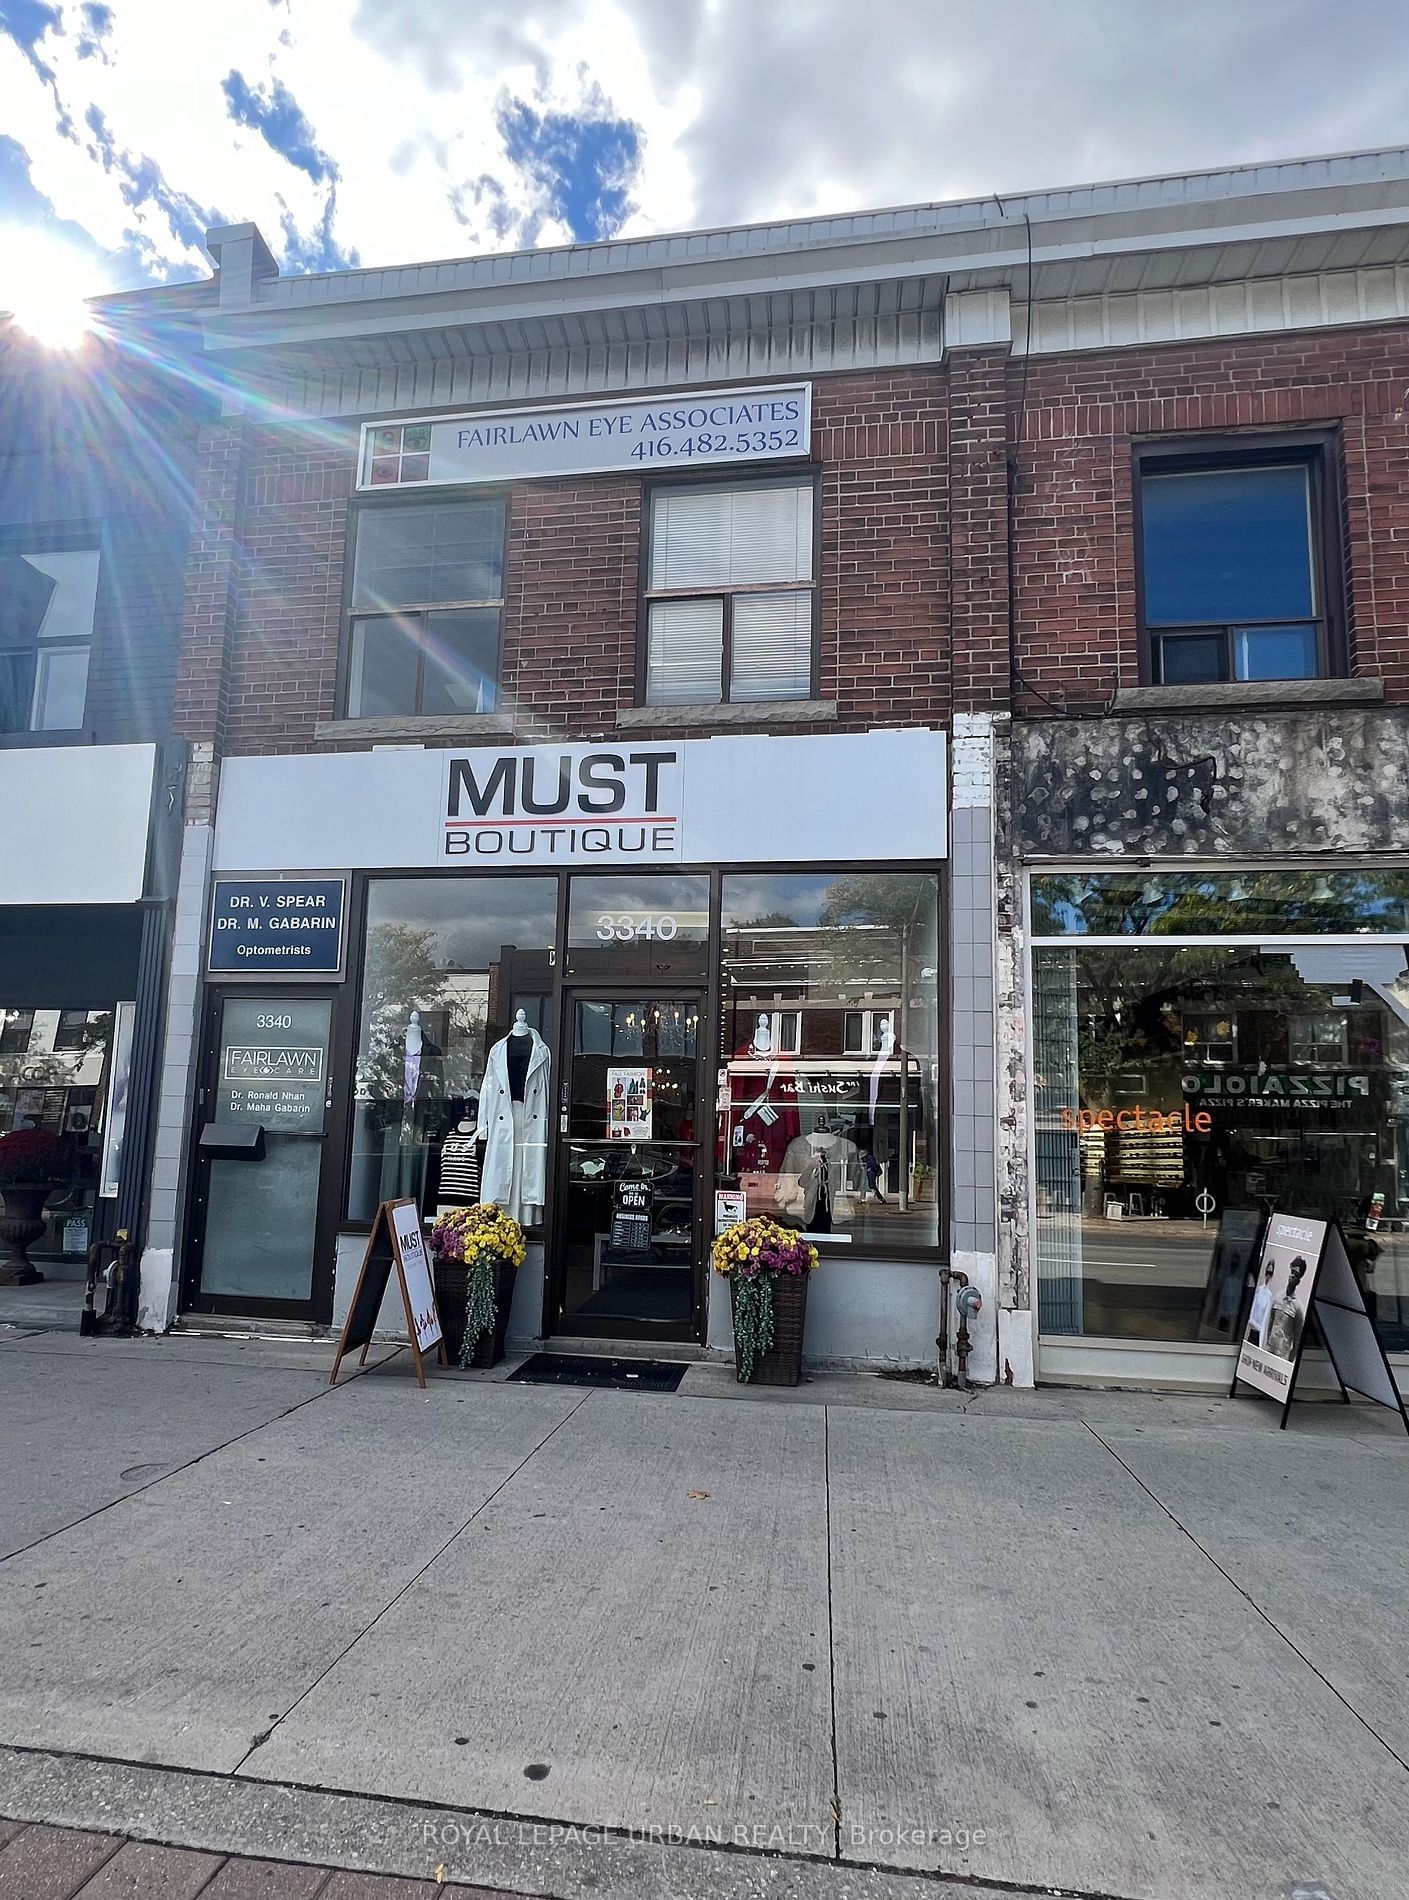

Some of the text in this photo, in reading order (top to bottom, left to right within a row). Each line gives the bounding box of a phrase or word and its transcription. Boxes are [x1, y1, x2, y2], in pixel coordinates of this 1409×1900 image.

[457, 401, 799, 448] FAIRLAWN EYE ASSOCIATES
[631, 429, 799, 461] 416.482.5352
[447, 752, 677, 816] MUST
[445, 827, 675, 855] BOUTIQUE
[230, 895, 326, 908] DR. V. SPEAR
[217, 917, 336, 930] DR. M. GABARIN
[596, 915, 677, 941] 3340
[237, 945, 311, 957] Optometrists
[256, 1014, 292, 1029] 3340
[231, 1050, 317, 1066] FAIRLAWN
[231, 1090, 244, 1099] Dr.
[247, 1091, 278, 1099] Ronald
[230, 1102, 243, 1111] Dr.
[274, 1103, 311, 1113] Gabarin
[1061, 1102, 1212, 1135] spectacle
[622, 1194, 645, 1206] OPEN
[66, 1219, 86, 1227] PASS
[400, 1230, 421, 1253] MUST
